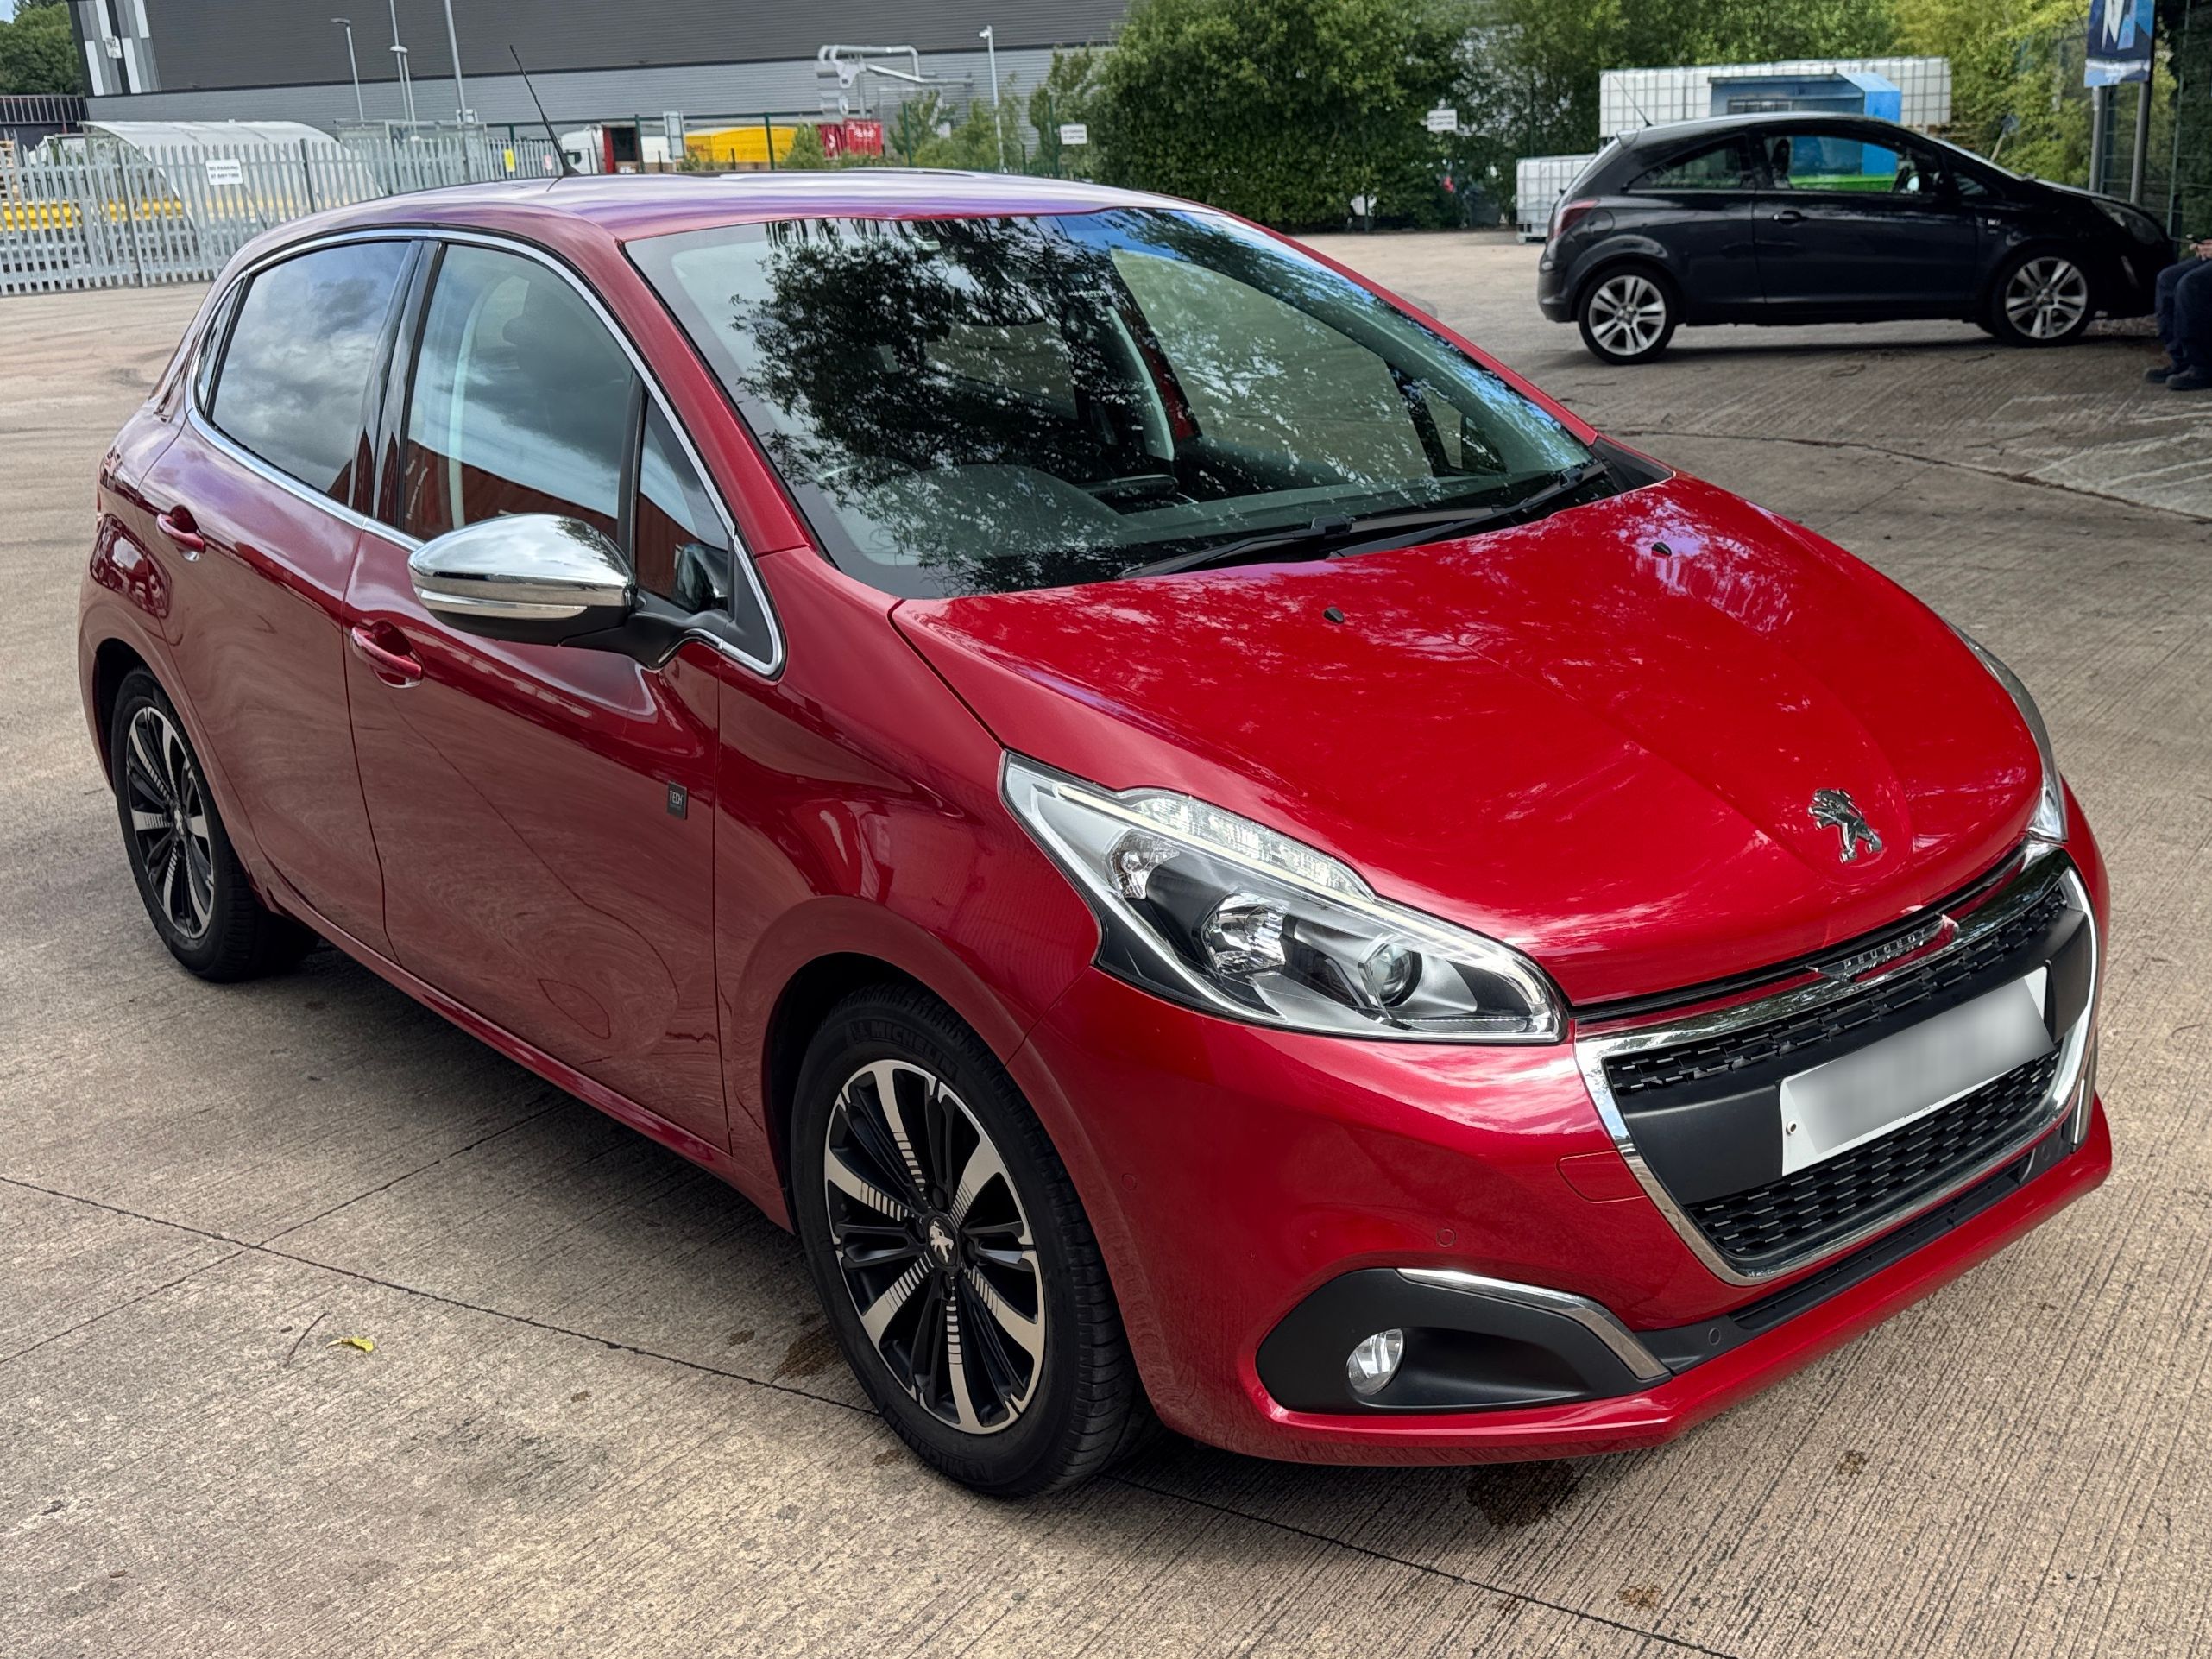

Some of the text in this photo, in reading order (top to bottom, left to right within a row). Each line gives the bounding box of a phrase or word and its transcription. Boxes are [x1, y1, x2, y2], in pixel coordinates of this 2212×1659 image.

[669, 790, 684, 806] TECH
[1843, 928, 1925, 970] PEUGEOT
[870, 1020, 959, 1081] MICHELIN
